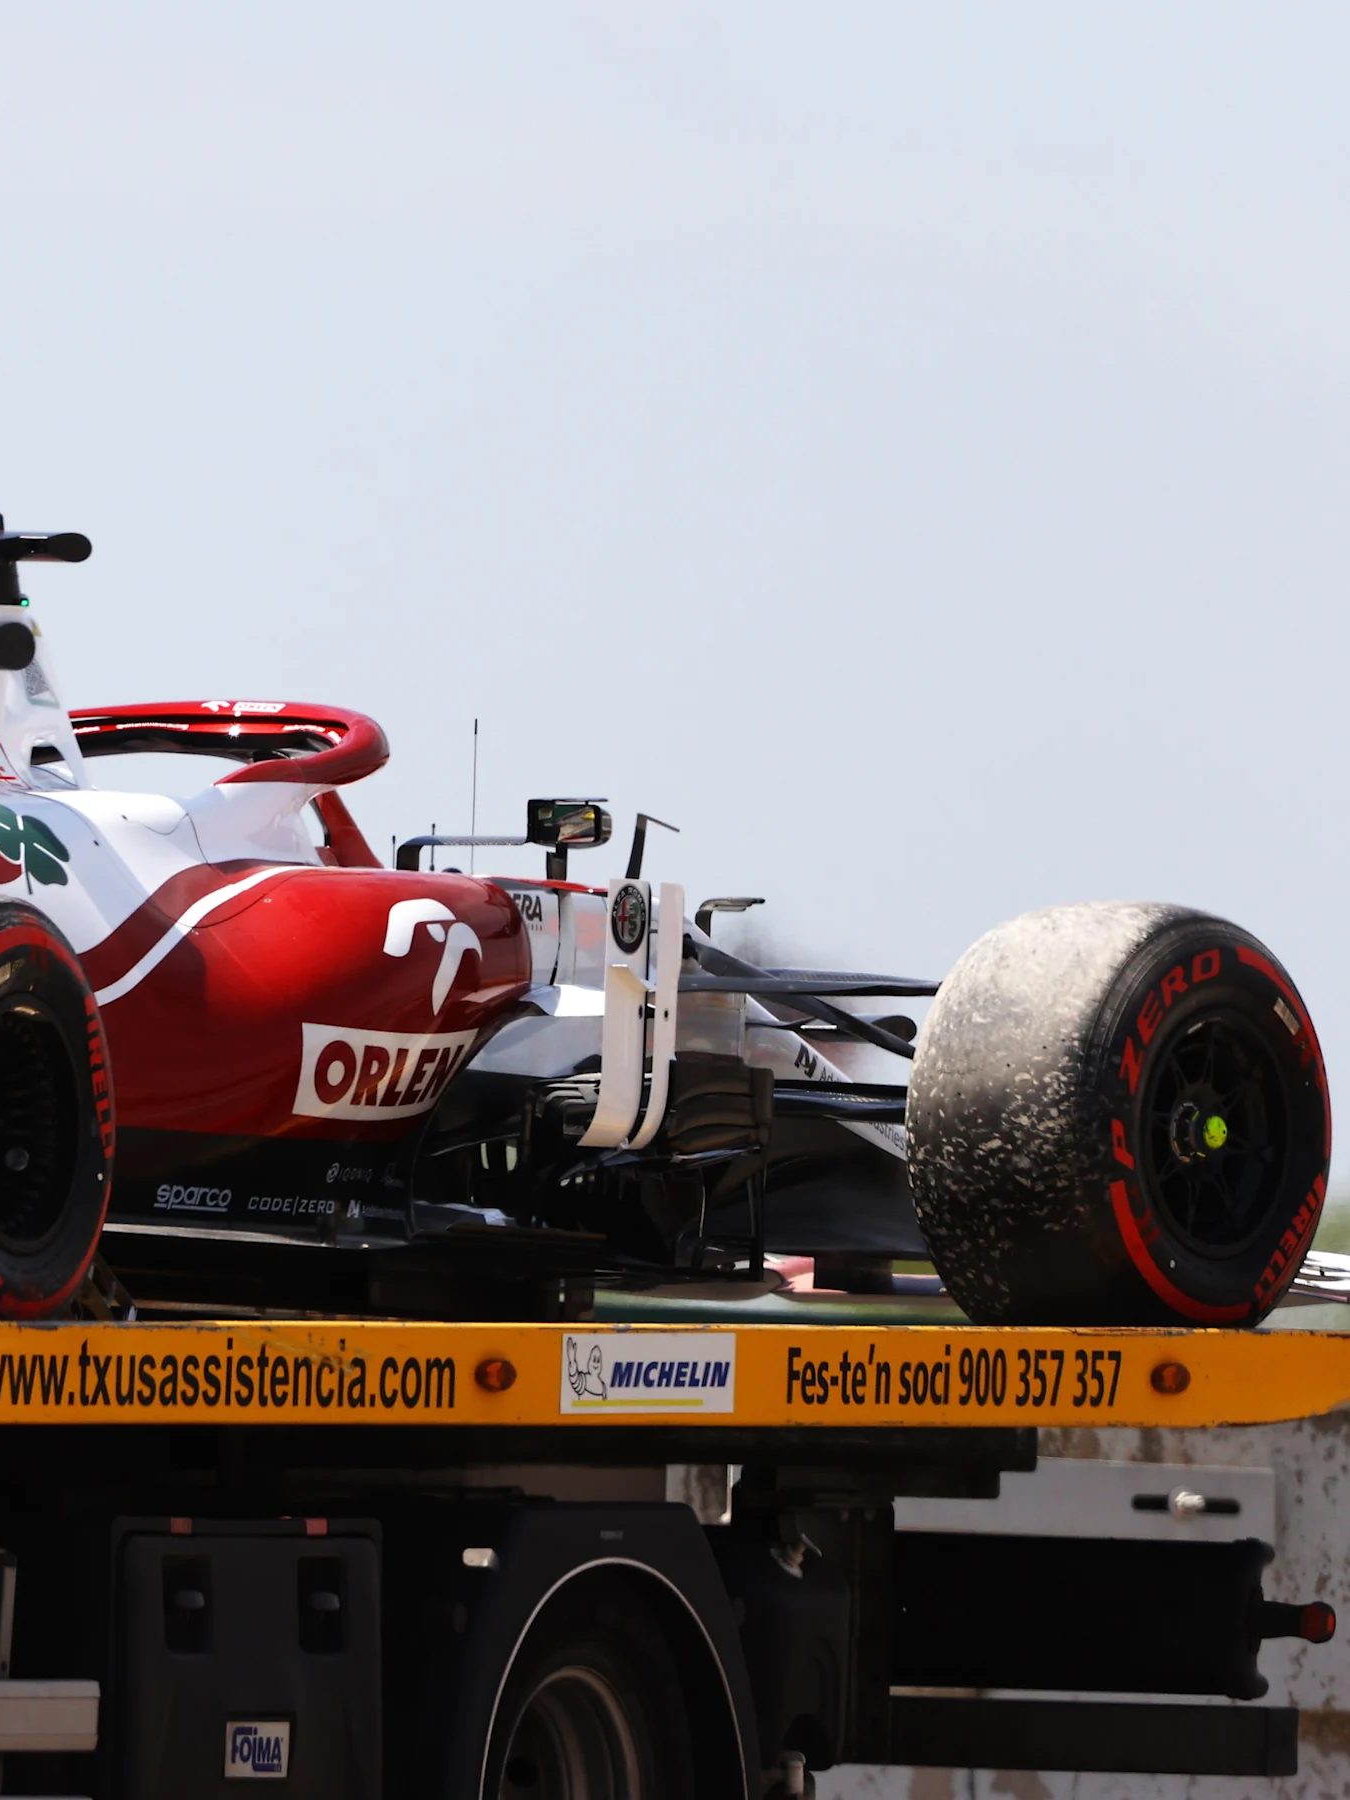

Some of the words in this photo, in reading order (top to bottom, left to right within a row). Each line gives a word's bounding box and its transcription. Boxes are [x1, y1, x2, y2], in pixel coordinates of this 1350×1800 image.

[1118, 947, 1221, 1096] ZERO
[314, 1039, 465, 1108] ORLEN
[1110, 1117, 1135, 1171] P
[156, 1184, 233, 1210] sparco
[609, 1361, 732, 1388] MICHELIN
[897, 1343, 951, 1405] soci
[958, 1347, 1008, 1406] 900
[1015, 1348, 1065, 1407] 357
[1072, 1349, 1123, 1407] 357
